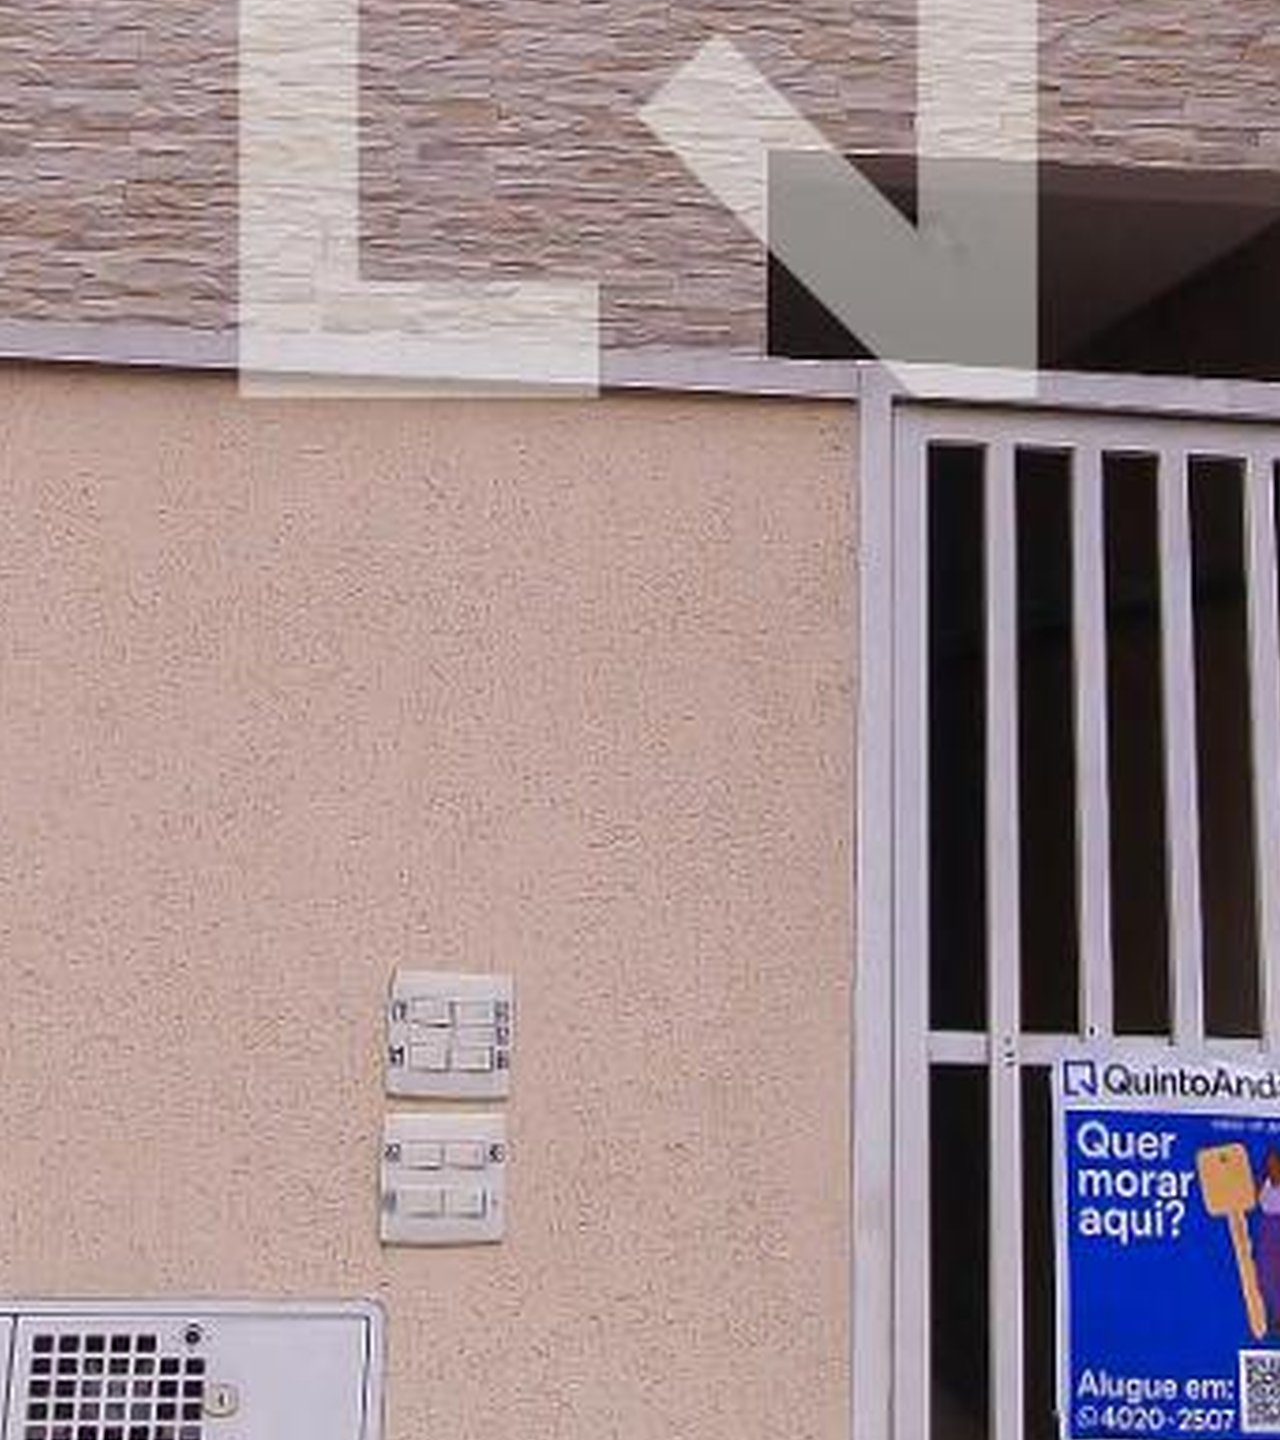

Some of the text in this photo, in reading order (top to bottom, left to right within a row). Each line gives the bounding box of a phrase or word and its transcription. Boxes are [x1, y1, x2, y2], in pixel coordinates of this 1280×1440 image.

[1077, 1121, 1177, 1160] Quer
[1077, 1168, 1195, 1198] morar
[1077, 1200, 1185, 1245] aqui?
[1076, 1369, 1235, 1404] Alugue em:
